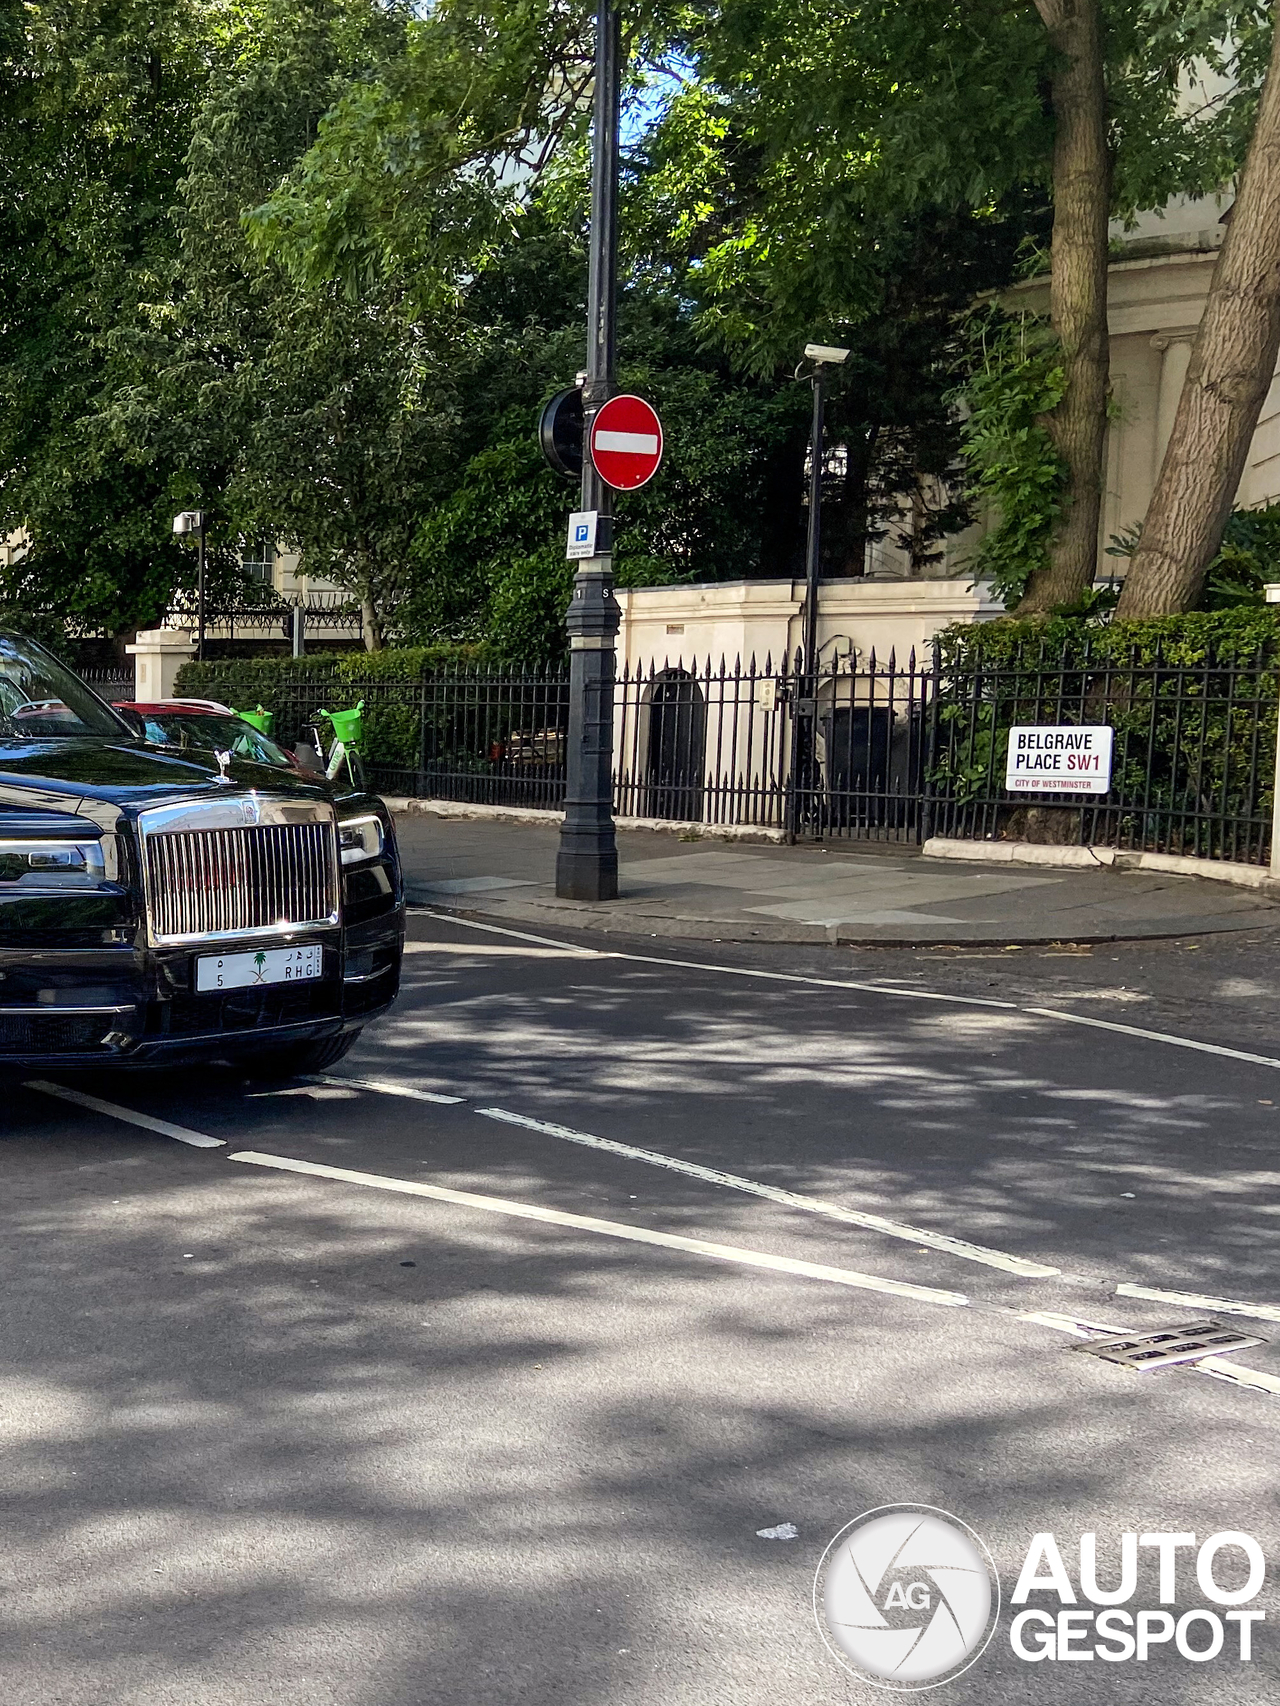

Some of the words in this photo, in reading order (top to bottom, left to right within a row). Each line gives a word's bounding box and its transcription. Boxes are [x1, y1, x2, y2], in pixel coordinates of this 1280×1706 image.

[1017, 733, 1093, 750] BELGRAVE
[1016, 753, 1062, 770] PLACE
[1067, 754, 1099, 771] SW1
[1015, 779, 1030, 788] CITY
[1031, 780, 1041, 788] OF
[1042, 780, 1092, 789] WESTMINSTER
[217, 974, 224, 987] 5
